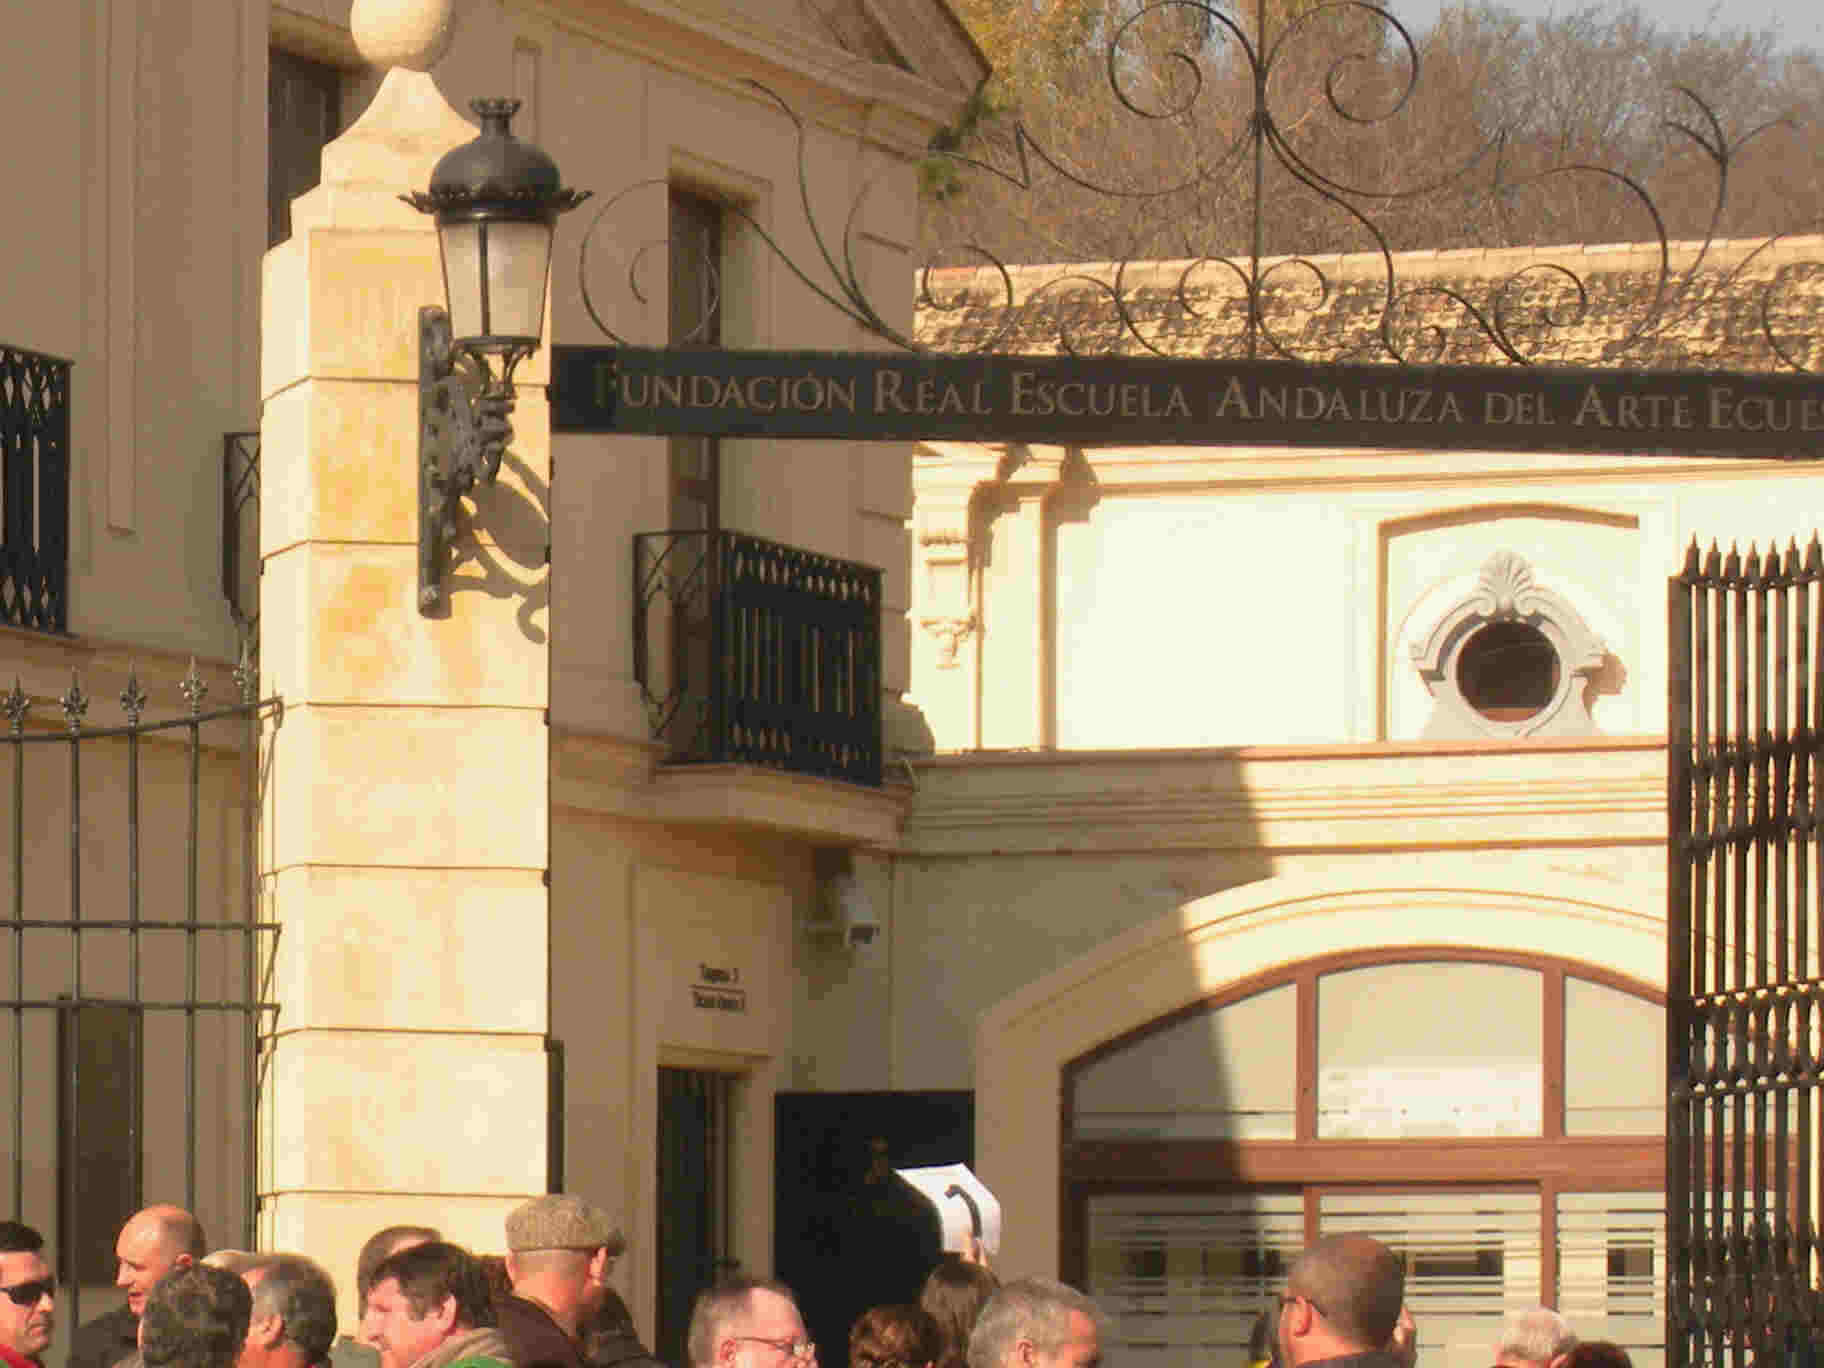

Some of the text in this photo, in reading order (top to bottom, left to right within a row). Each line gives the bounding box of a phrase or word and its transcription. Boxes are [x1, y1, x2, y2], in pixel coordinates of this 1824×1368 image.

[872, 368, 993, 416] REAL
[1008, 369, 1193, 417] ESCUELA
[1215, 376, 1464, 424] ANDALUZA
[1484, 391, 1556, 425] DEL
[1572, 383, 1695, 430] ARTE
[1706, 384, 1824, 432] ECUE
